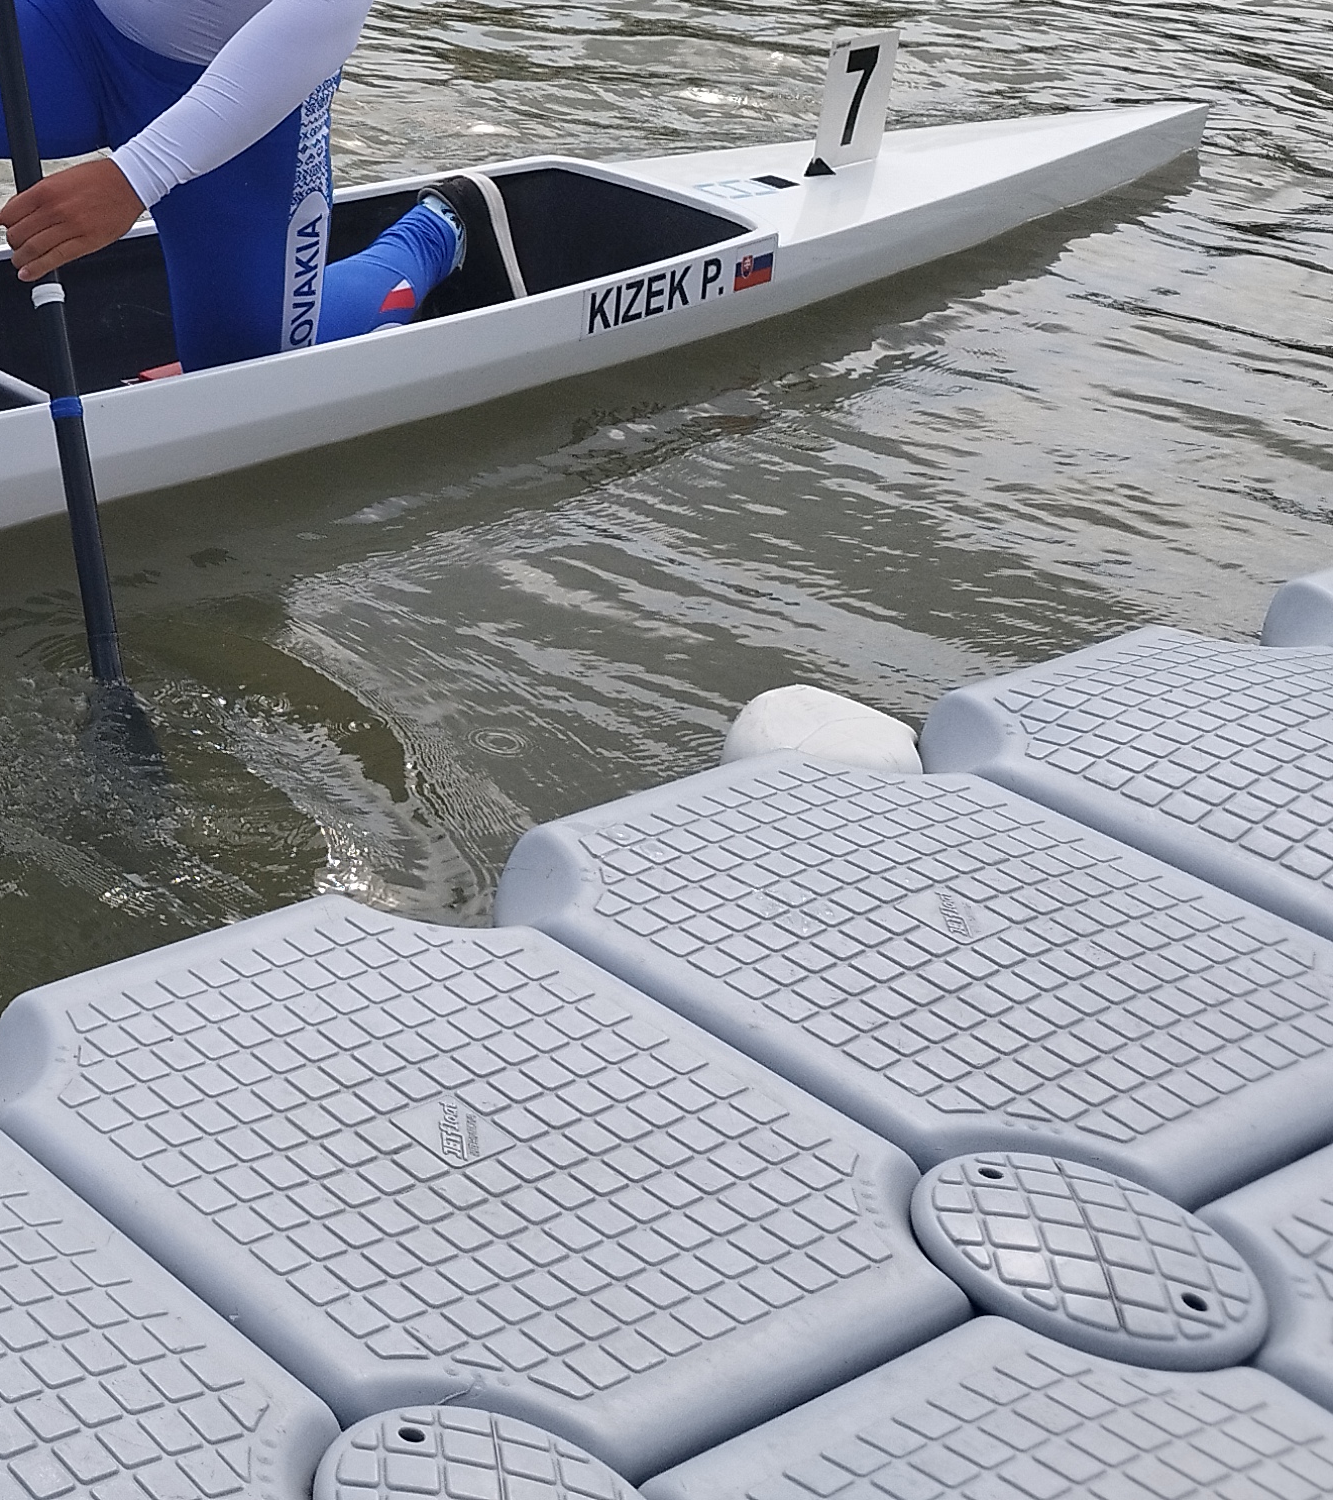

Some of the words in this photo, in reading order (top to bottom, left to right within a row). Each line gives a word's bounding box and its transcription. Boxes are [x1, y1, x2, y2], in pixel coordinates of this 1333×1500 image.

[841, 45, 881, 147] 7
[289, 213, 323, 347] OVAKIA
[587, 265, 689, 335] KIZEK
[700, 258, 724, 301] P.
